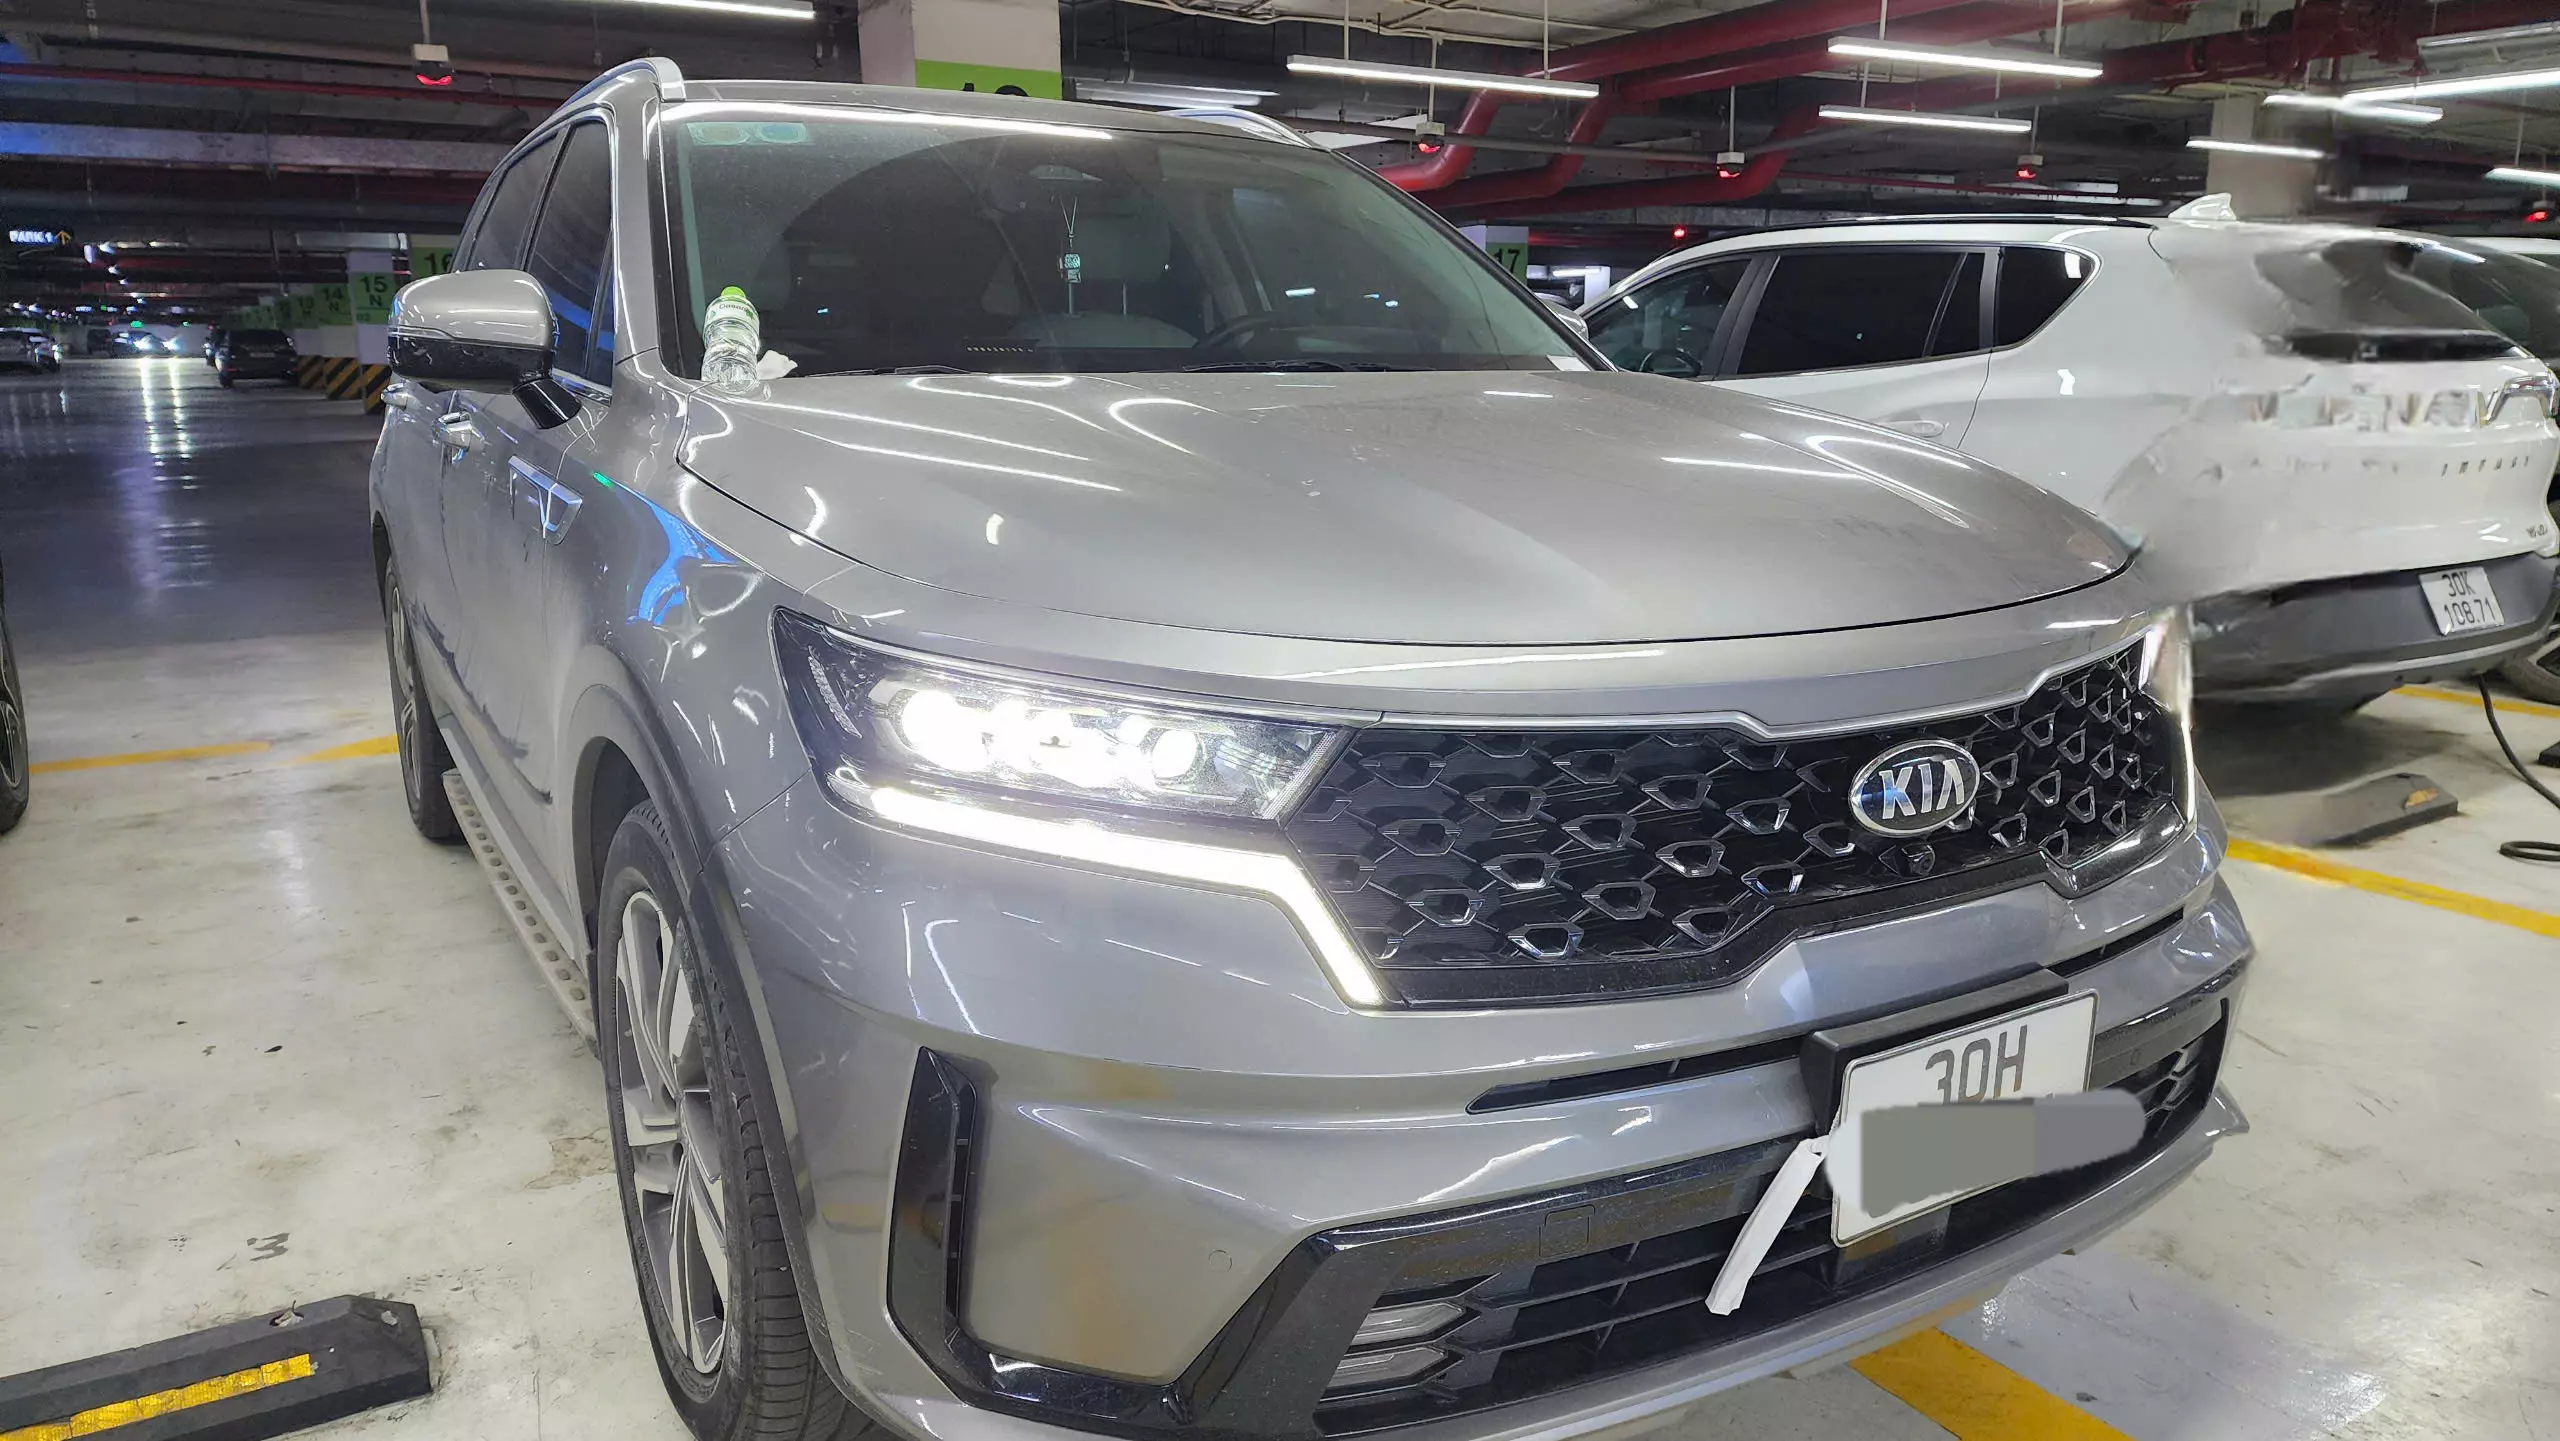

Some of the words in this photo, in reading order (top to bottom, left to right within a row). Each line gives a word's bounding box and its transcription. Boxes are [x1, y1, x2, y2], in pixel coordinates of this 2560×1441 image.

[321, 286, 344, 301] 14
[359, 275, 388, 294] 15
[328, 300, 340, 312] N
[369, 293, 383, 308] N
[2441, 570, 2476, 597] 30K
[2443, 597, 2496, 628] 108.71
[1879, 759, 1965, 820] KIA
[1924, 1024, 2028, 1105] 30H
